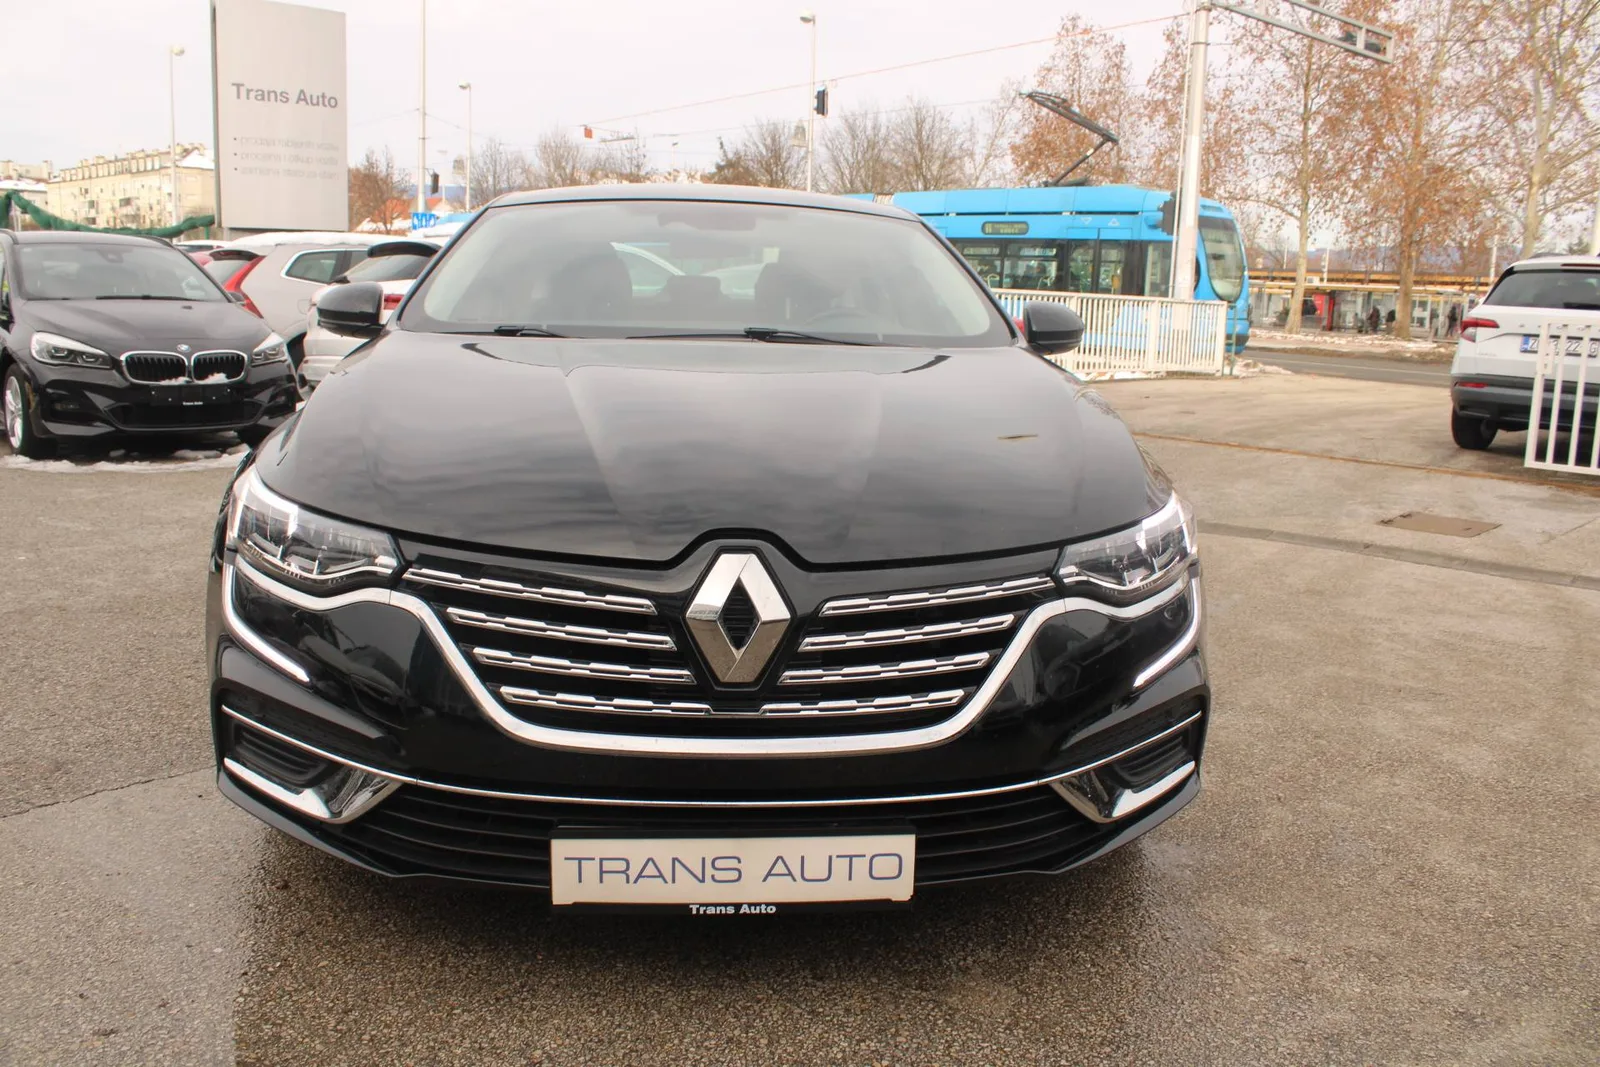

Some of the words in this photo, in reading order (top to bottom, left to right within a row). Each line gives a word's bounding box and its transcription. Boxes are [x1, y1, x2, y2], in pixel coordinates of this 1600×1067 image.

[231, 82, 290, 104] Trans
[295, 88, 339, 109] Auto
[564, 856, 743, 884] TRANS
[761, 852, 904, 883] AUTO
[689, 904, 736, 915] Trans
[739, 903, 777, 915] Auto
